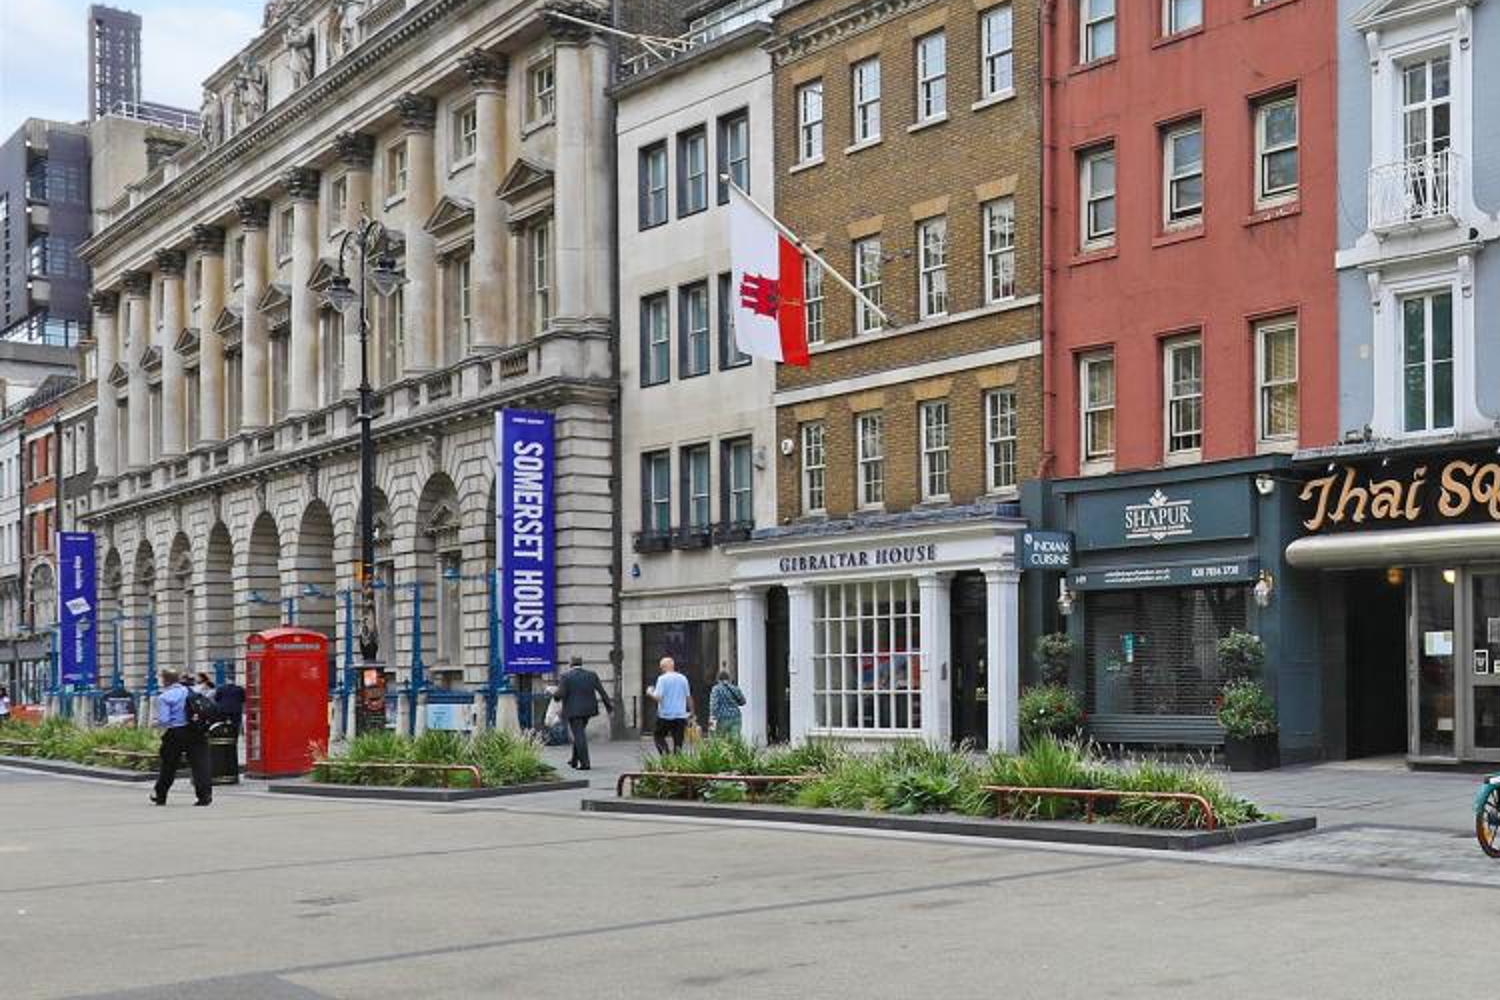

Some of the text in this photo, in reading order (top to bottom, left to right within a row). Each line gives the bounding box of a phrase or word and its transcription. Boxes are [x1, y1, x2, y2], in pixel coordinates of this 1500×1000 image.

[513, 441, 544, 562] SOMERSET
[1125, 506, 1192, 529] SHAPUR
[1300, 466, 1427, 532] Thai
[780, 544, 937, 573] GIBRALTAR HOUSE
[513, 569, 544, 645] HOUSE
